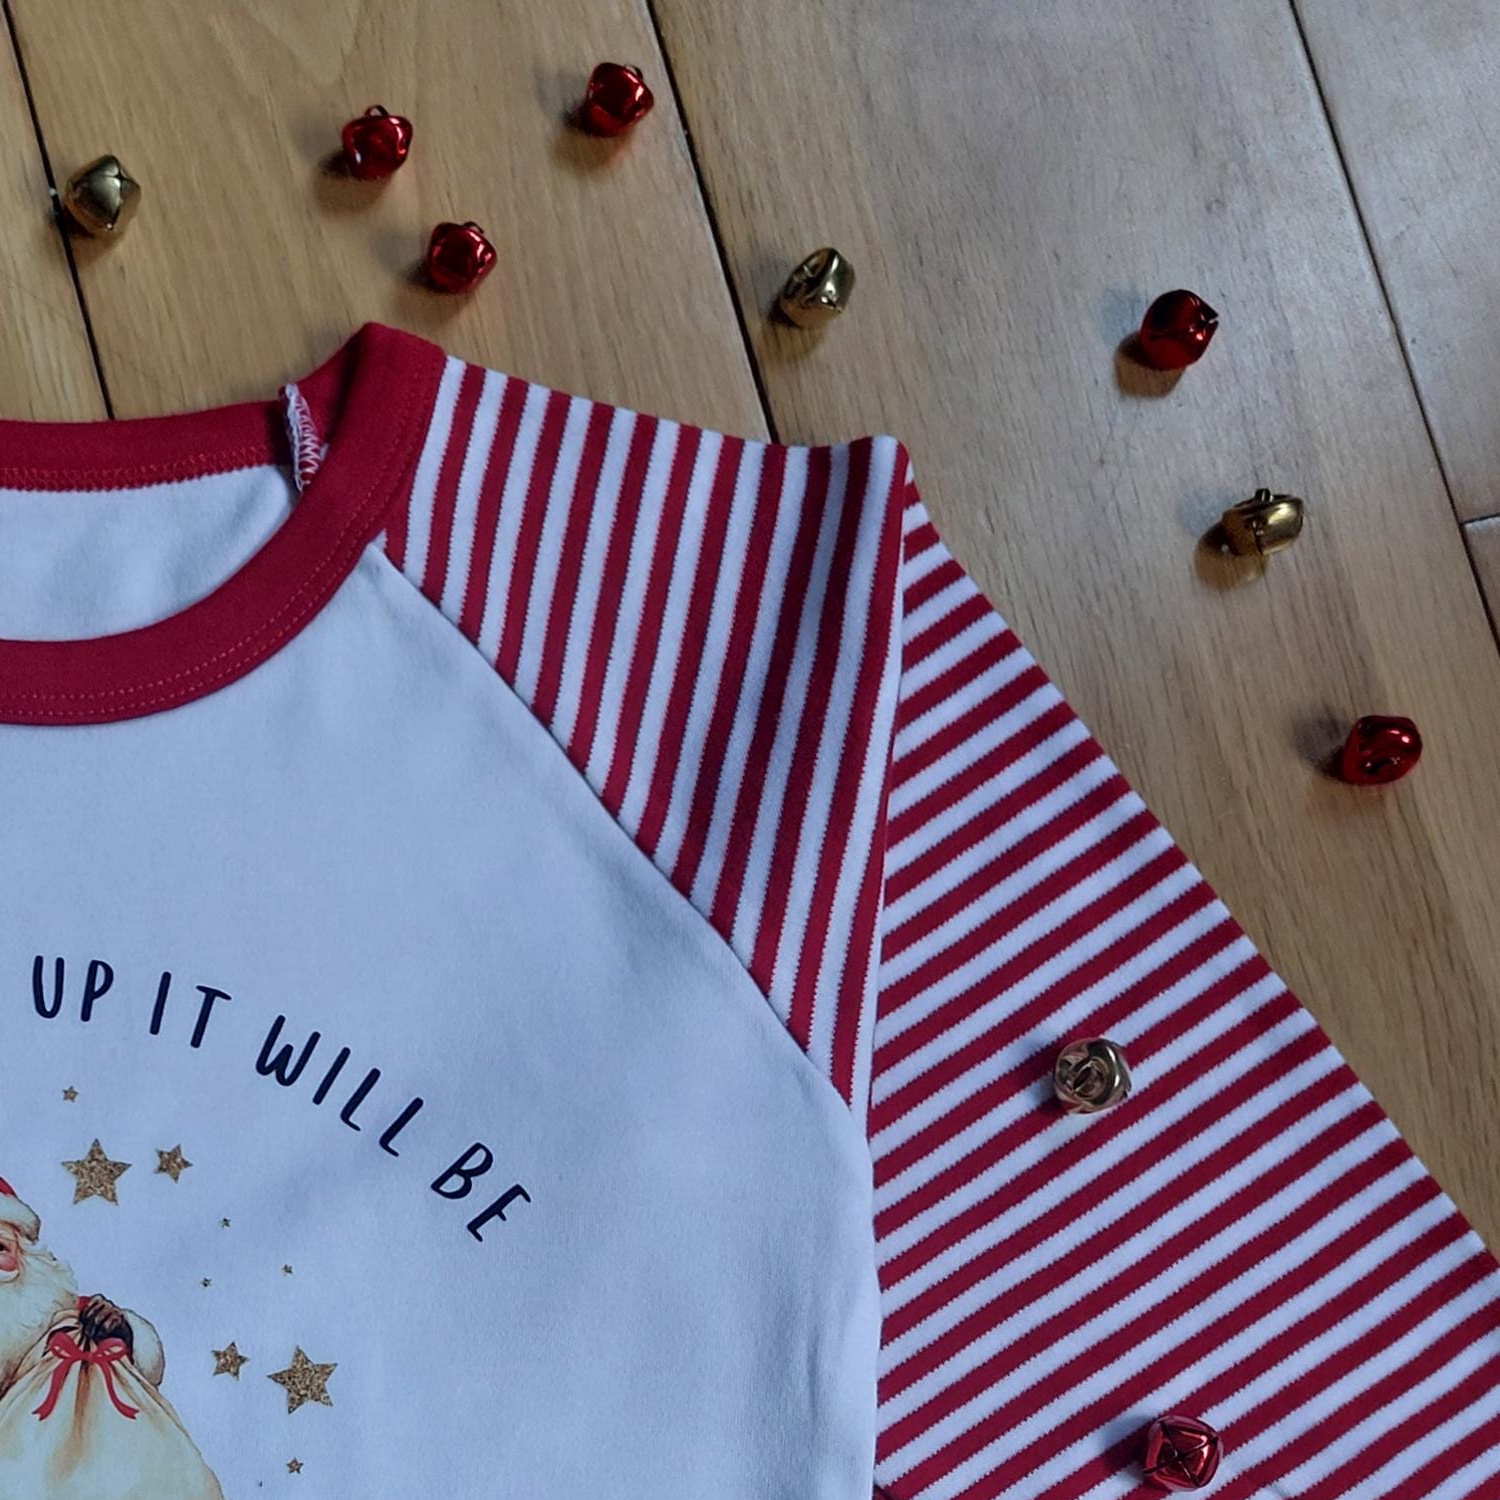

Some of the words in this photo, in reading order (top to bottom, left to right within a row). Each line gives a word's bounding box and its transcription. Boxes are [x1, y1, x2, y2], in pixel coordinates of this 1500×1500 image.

[32, 955, 114, 1023] UP
[149, 971, 232, 1049] IT
[255, 1014, 424, 1157] WILL
[430, 1142, 532, 1243] BE
